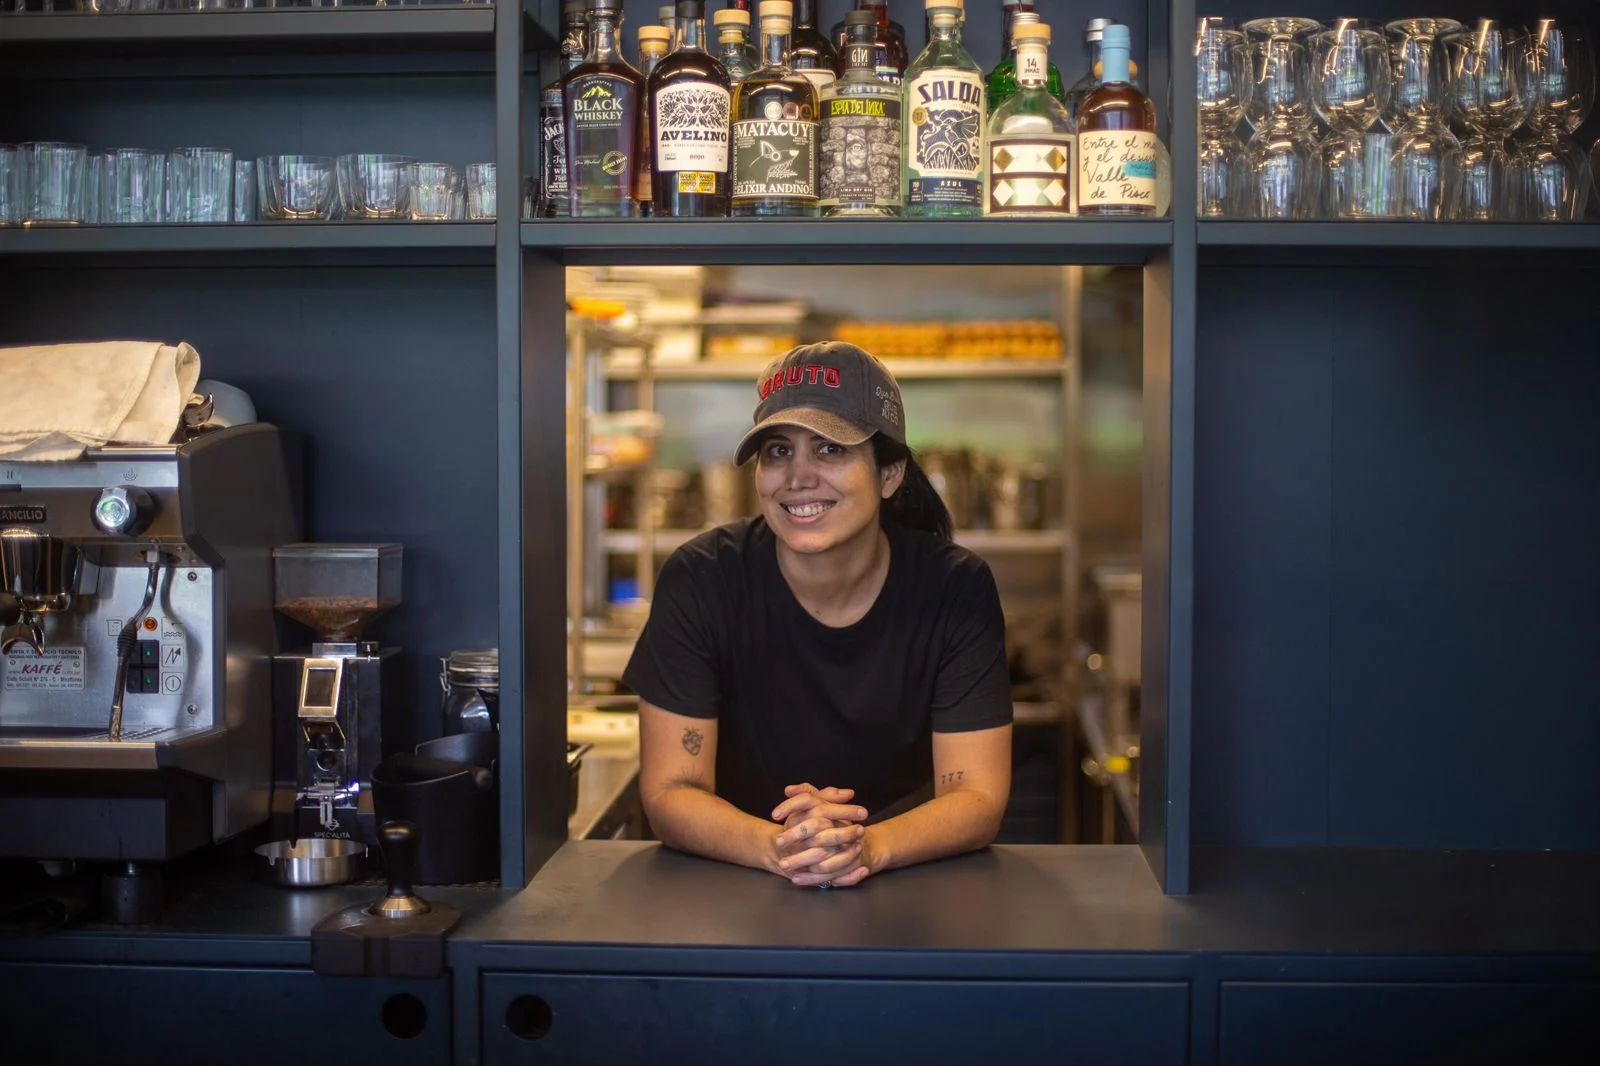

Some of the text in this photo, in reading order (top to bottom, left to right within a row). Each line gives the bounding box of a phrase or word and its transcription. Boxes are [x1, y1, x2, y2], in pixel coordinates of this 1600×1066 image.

[852, 47, 867, 62] GIN
[1026, 58, 1037, 68] 14
[917, 80, 981, 106] SALQA
[573, 97, 623, 111] BLACK
[574, 111, 623, 121] WHISKEY
[660, 130, 728, 142] AVELINO
[737, 122, 810, 137] MATACUY
[1082, 136, 1119, 151] Entre
[1124, 136, 1139, 149] el
[1082, 157, 1089, 172] y
[1096, 148, 1113, 163] el
[1087, 164, 1129, 184] Valle
[736, 183, 810, 194] ELIXIR ANDINO
[1090, 186, 1107, 200] de
[759, 364, 840, 400] BRUTO
[0, 510, 44, 520] ANCILIO
[21, 661, 62, 674] KAFFÉ
